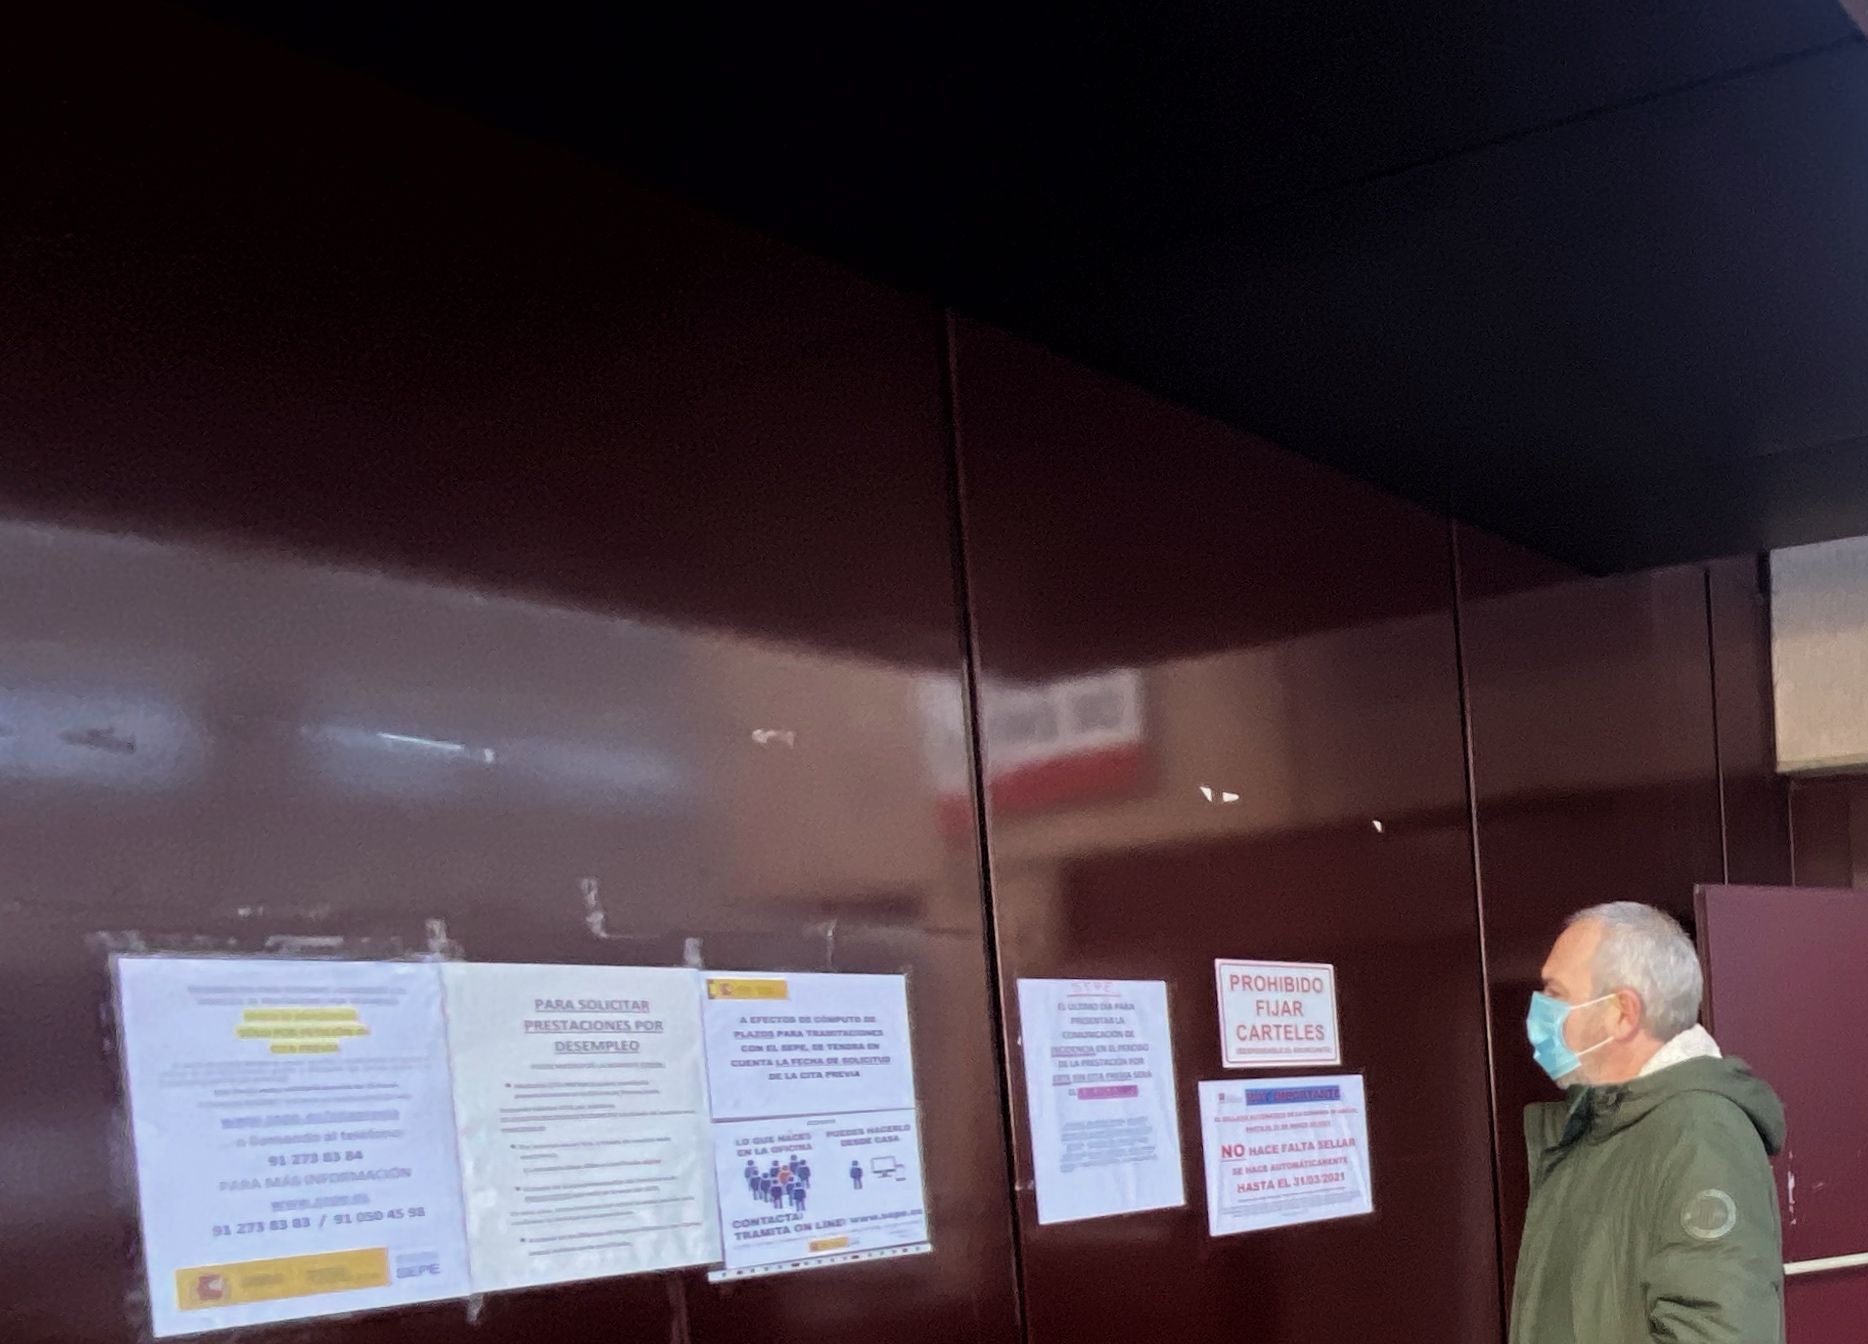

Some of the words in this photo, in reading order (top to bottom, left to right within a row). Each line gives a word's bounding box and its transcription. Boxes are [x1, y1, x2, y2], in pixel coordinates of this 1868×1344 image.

[1229, 974, 1324, 993] PROHIBIDO
[534, 999, 575, 1011] PARA
[579, 1000, 651, 1012] SOLICITAR
[1255, 999, 1304, 1017] FIJAR
[524, 1020, 632, 1032] PRESTACIONES
[635, 1021, 664, 1032] POR
[750, 1016, 796, 1024] EFECTOS
[734, 1031, 774, 1039] PLAZOS
[807, 1029, 884, 1037] TRAMITACIONES
[1236, 1024, 1325, 1041] CARTELES
[554, 1041, 641, 1052] DESEMPLEO
[730, 1059, 774, 1067] CUENTA
[791, 1058, 823, 1066] FECHA
[842, 1056, 891, 1064] SOLICITUD
[785, 1072, 798, 1080] LA
[800, 1071, 823, 1079] CITA
[825, 1071, 861, 1079] PREVIA
[875, 1135, 900, 1144] CASA
[1221, 1143, 1245, 1159] NO
[1248, 1144, 1279, 1156] HACE
[1281, 1141, 1315, 1153] FALTA
[1317, 1138, 1356, 1149] SELLAR
[267, 1155, 286, 1166] 91
[291, 1153, 318, 1165] 273
[1245, 1165, 1268, 1174] HACE
[219, 1178, 261, 1191] PARA
[1237, 1180, 1275, 1193] HASTA
[1277, 1178, 1291, 1188] EL
[1293, 1172, 1346, 1187] 31/03/2021
[212, 1224, 232, 1237] 91
[236, 1221, 265, 1235] 273
[333, 1214, 352, 1225] 91
[387, 1208, 405, 1219] 45
[734, 1226, 791, 1241] TRAMITA
[794, 1222, 813, 1233] ON
